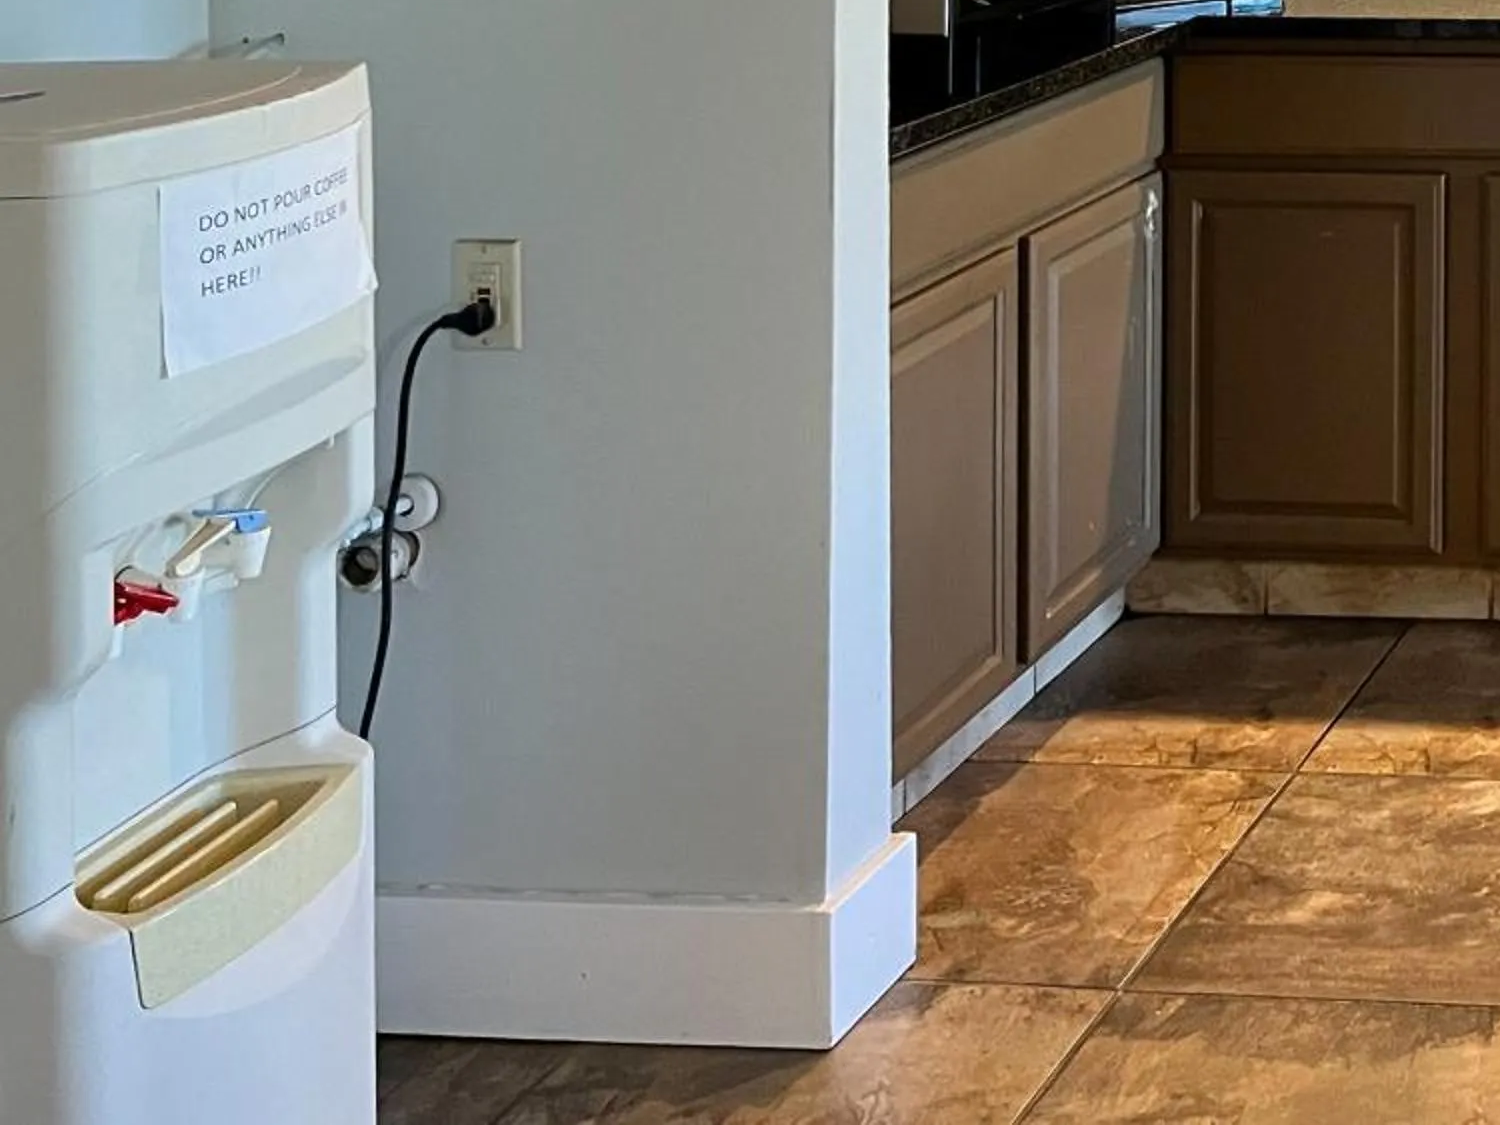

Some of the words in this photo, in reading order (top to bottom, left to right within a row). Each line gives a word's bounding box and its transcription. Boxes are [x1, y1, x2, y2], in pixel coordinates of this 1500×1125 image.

[199, 210, 229, 232] DO
[233, 198, 268, 224] NOT
[273, 183, 311, 211] POUR
[313, 167, 348, 196] COFFEE
[199, 244, 227, 264] OR
[231, 215, 311, 257] ANYTHING
[313, 204, 337, 228] ELSE
[200, 266, 261, 297] HERE!!
